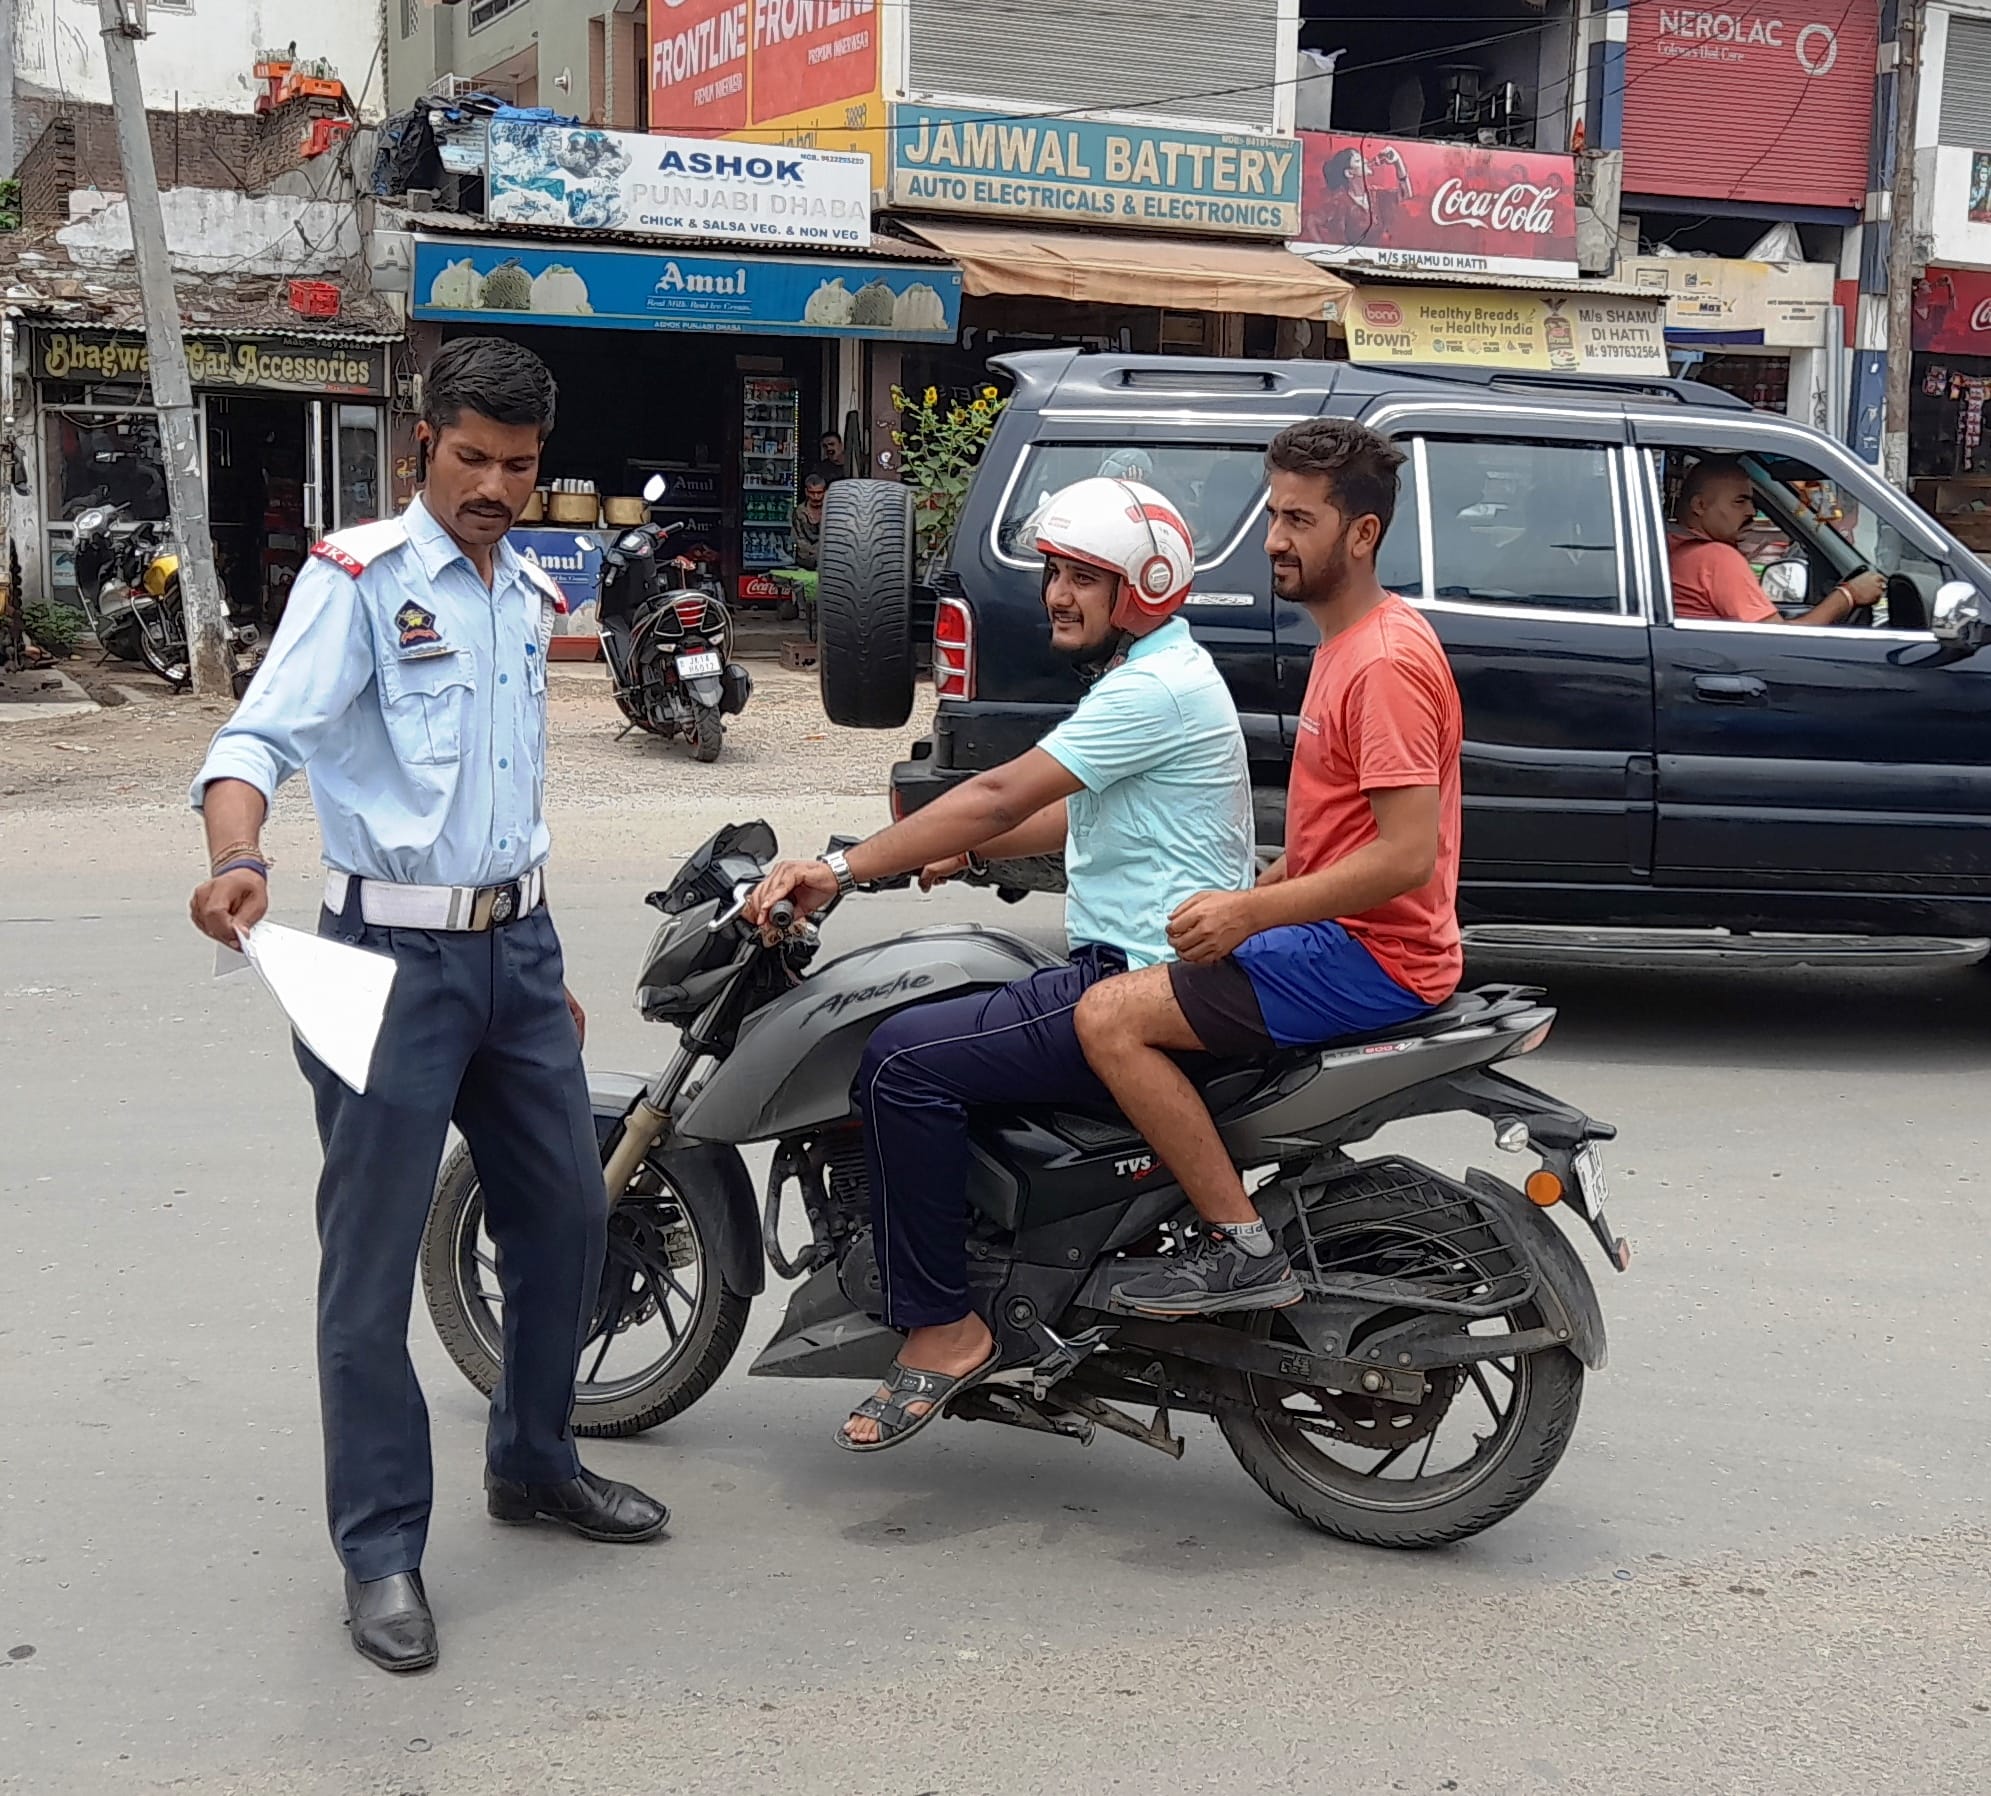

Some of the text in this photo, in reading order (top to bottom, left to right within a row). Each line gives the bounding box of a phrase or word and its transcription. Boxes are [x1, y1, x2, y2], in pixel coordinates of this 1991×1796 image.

[1660, 8, 1783, 46] NEROLAC
[652, 2, 747, 90] FRONTLINE
[658, 150, 804, 182] ASHOK
[904, 117, 1293, 196] JAMWAL BATTERY
[632, 183, 866, 220] PUNJABI DHABA
[908, 176, 1282, 227] AUTO ELECTRICALS & ELECTRONICS
[1431, 177, 1560, 233] Coca-Cola
[640, 214, 858, 240] CHICK & SALSA VEG. & NON VEG
[1378, 251, 1487, 270] M/S SHAMU DI HATTI
[655, 261, 746, 295] Amul
[1366, 308, 1398, 321] bonn
[1420, 306, 1519, 321] Healthy Breads
[1579, 308, 1657, 324] M/s SHAMU
[1354, 328, 1411, 347] Brown
[1445, 322, 1497, 337] Healthy
[1500, 323, 1532, 336] India
[1592, 328, 1650, 342] DI HATTI
[187, 342, 230, 380] Car
[236, 345, 369, 385] Accessories
[1585, 345, 1598, 357] M:
[316, 543, 356, 567] JKP
[523, 546, 584, 570] Amul
[799, 970, 935, 1029] Apache
[1114, 1155, 1151, 1176] TVS
